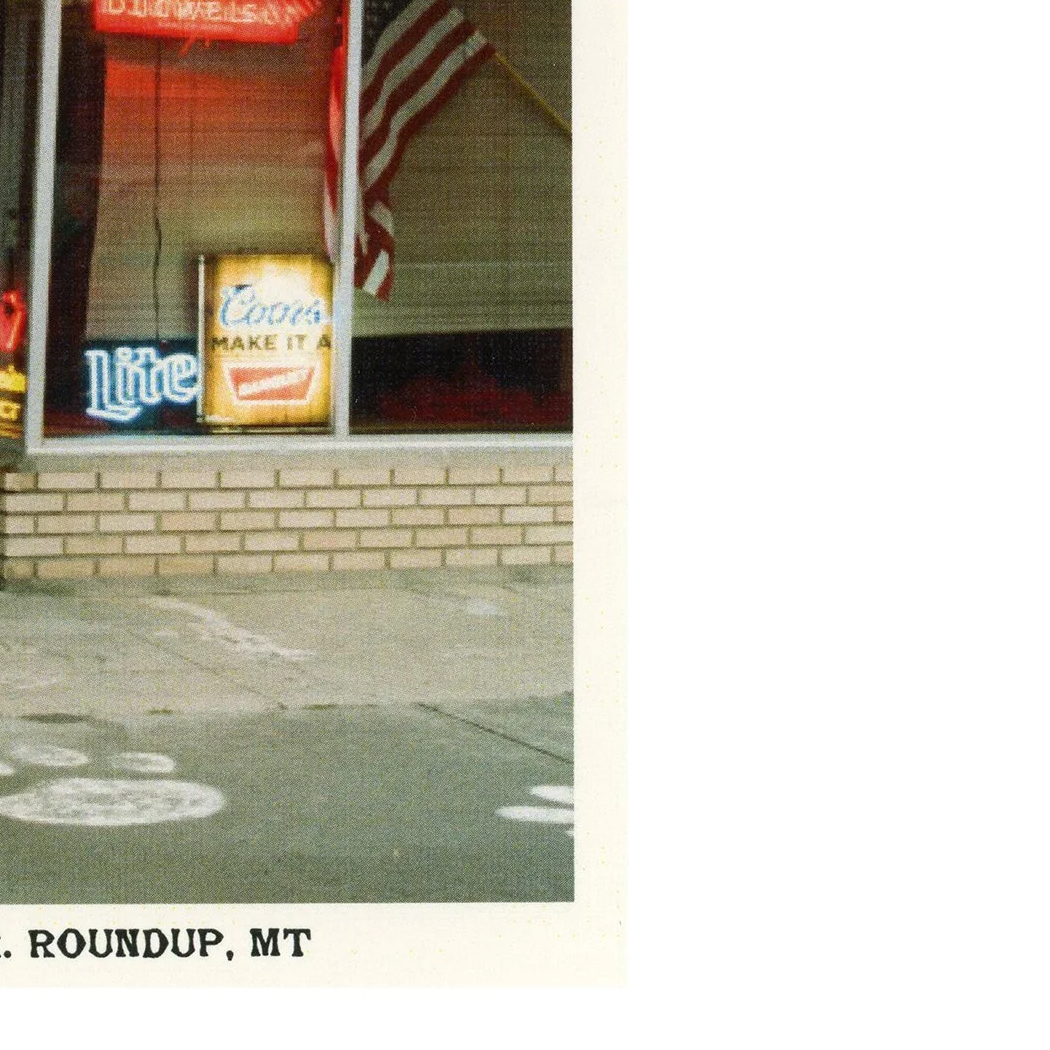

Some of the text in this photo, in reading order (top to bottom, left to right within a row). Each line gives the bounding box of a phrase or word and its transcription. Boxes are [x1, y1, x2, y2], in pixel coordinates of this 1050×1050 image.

[210, 333, 278, 352] MAKE
[287, 333, 309, 351] IT
[84, 346, 198, 423] Lite
